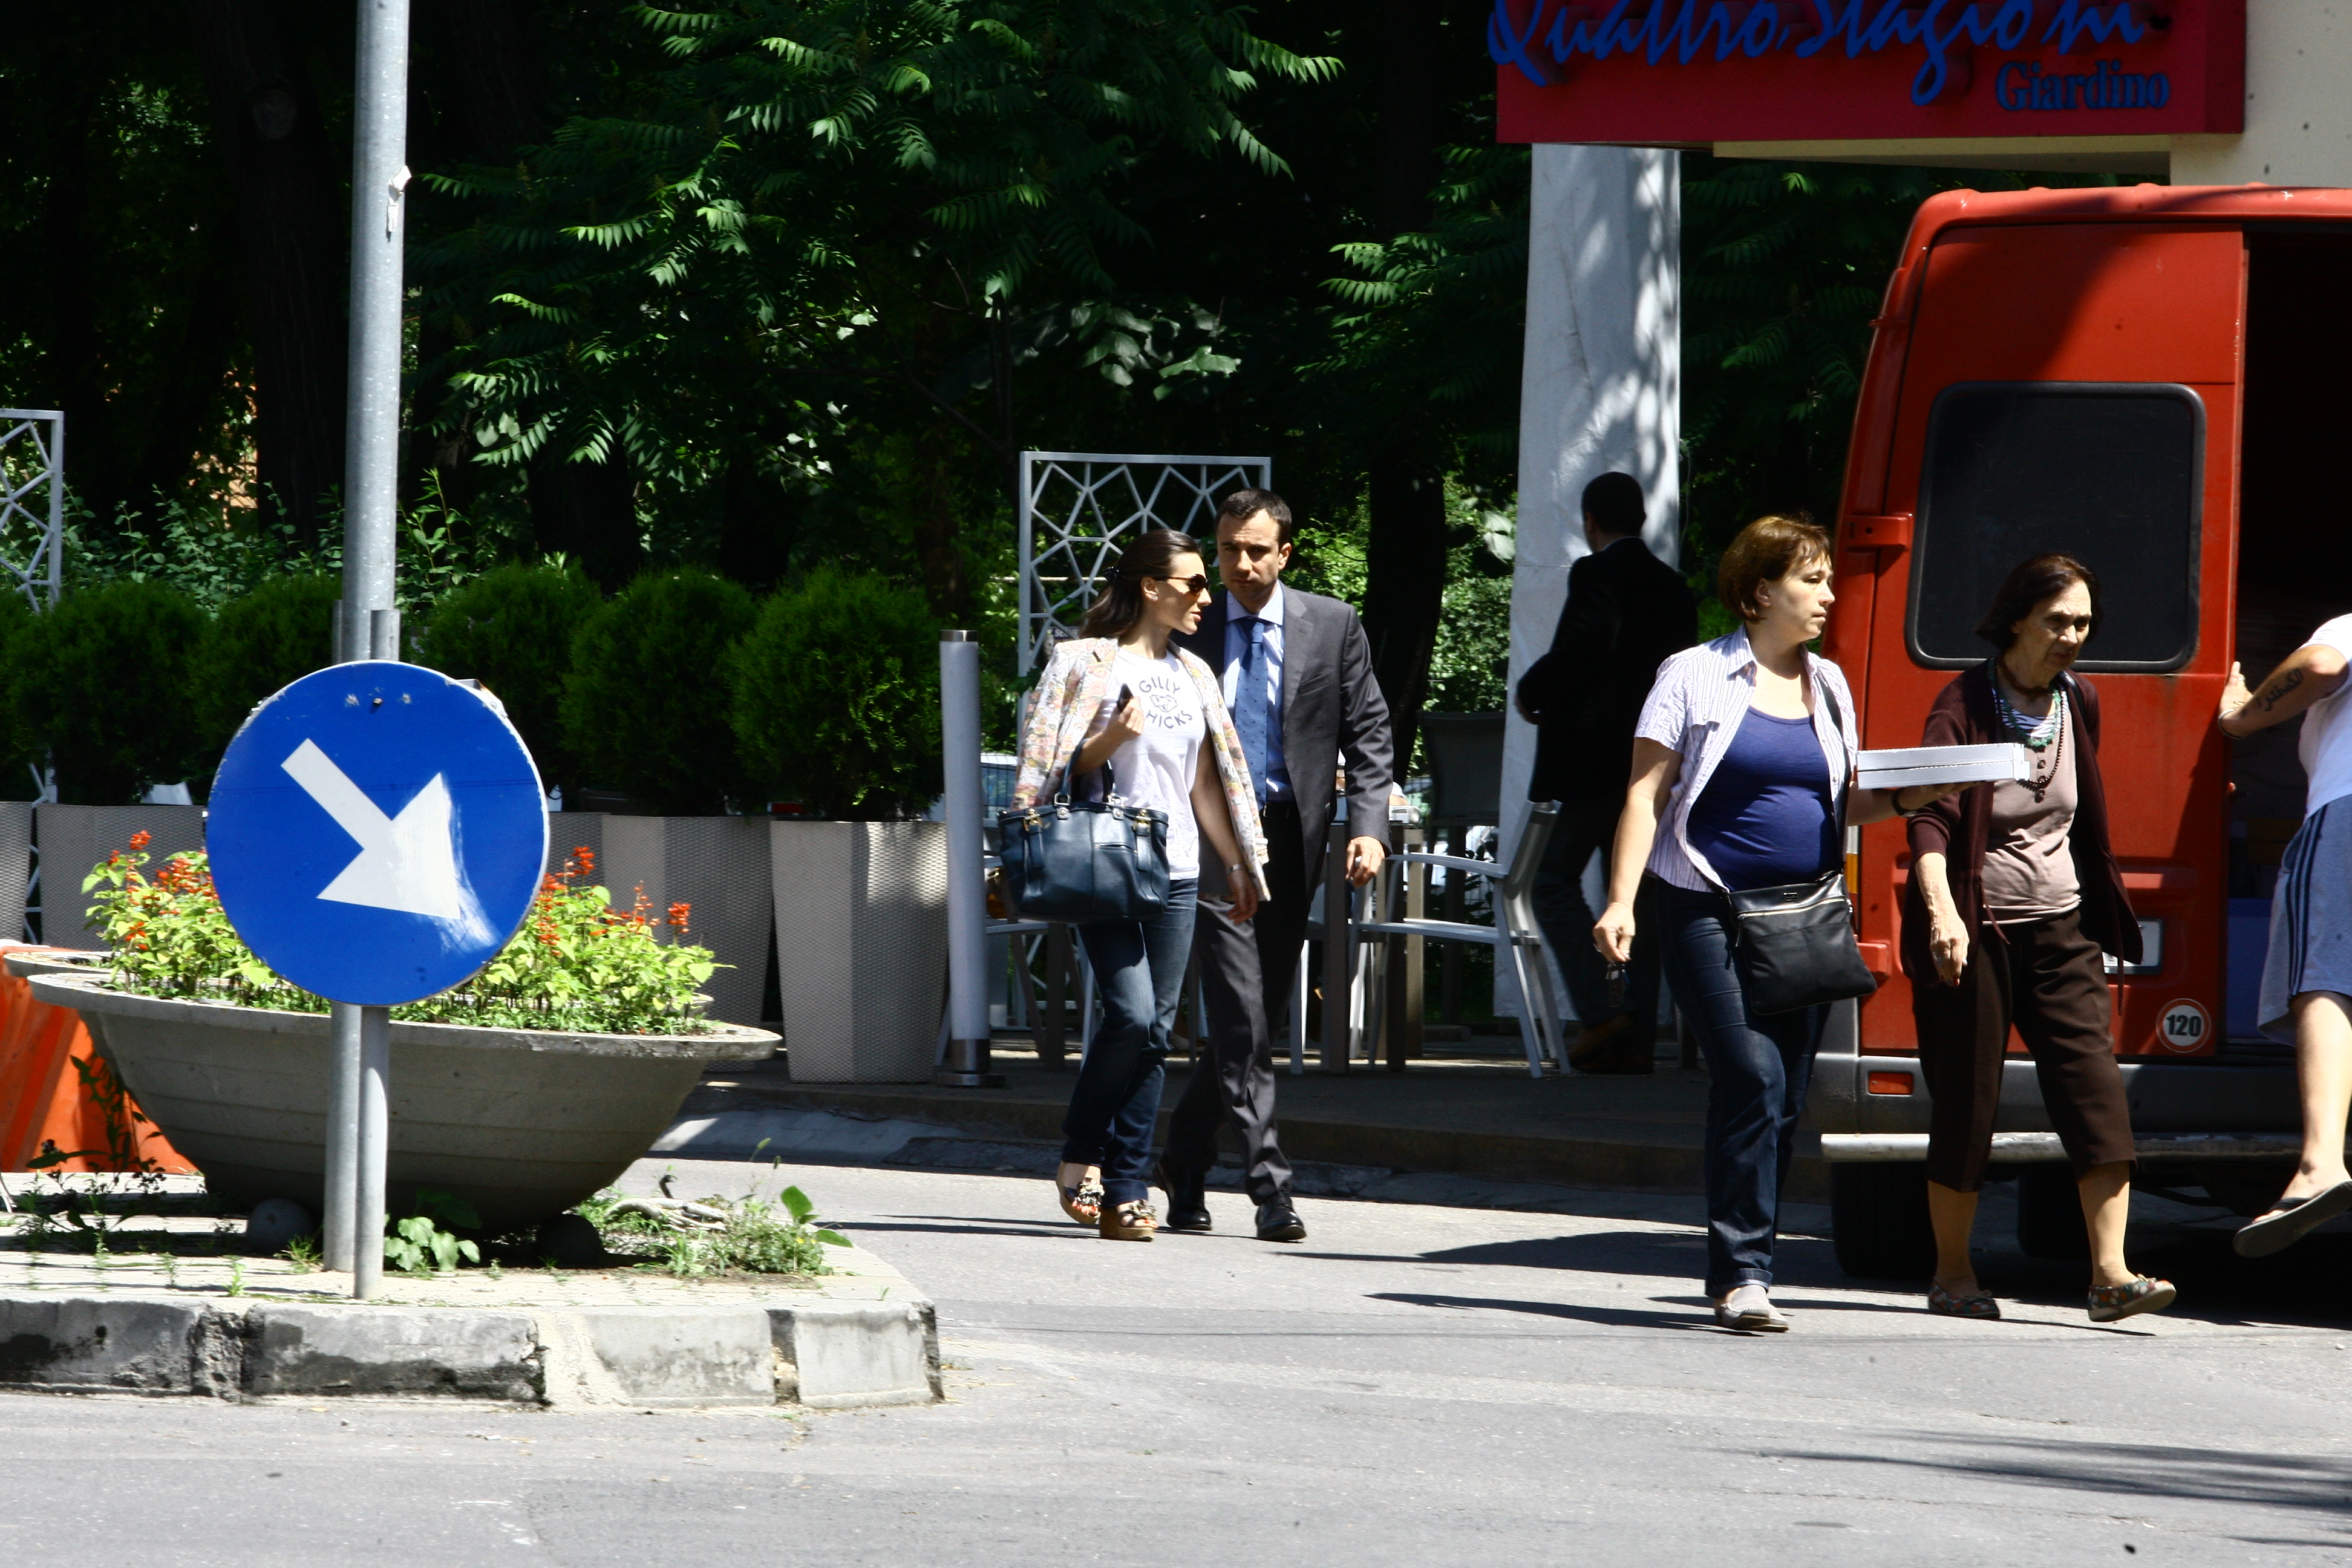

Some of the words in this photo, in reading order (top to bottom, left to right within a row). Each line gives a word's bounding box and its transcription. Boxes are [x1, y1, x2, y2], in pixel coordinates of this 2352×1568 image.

[1996, 59, 2170, 110] Giardino
[1139, 676, 1180, 694] GILLY
[1145, 710, 1193, 729] HICKS
[2166, 1014, 2201, 1037] 120
